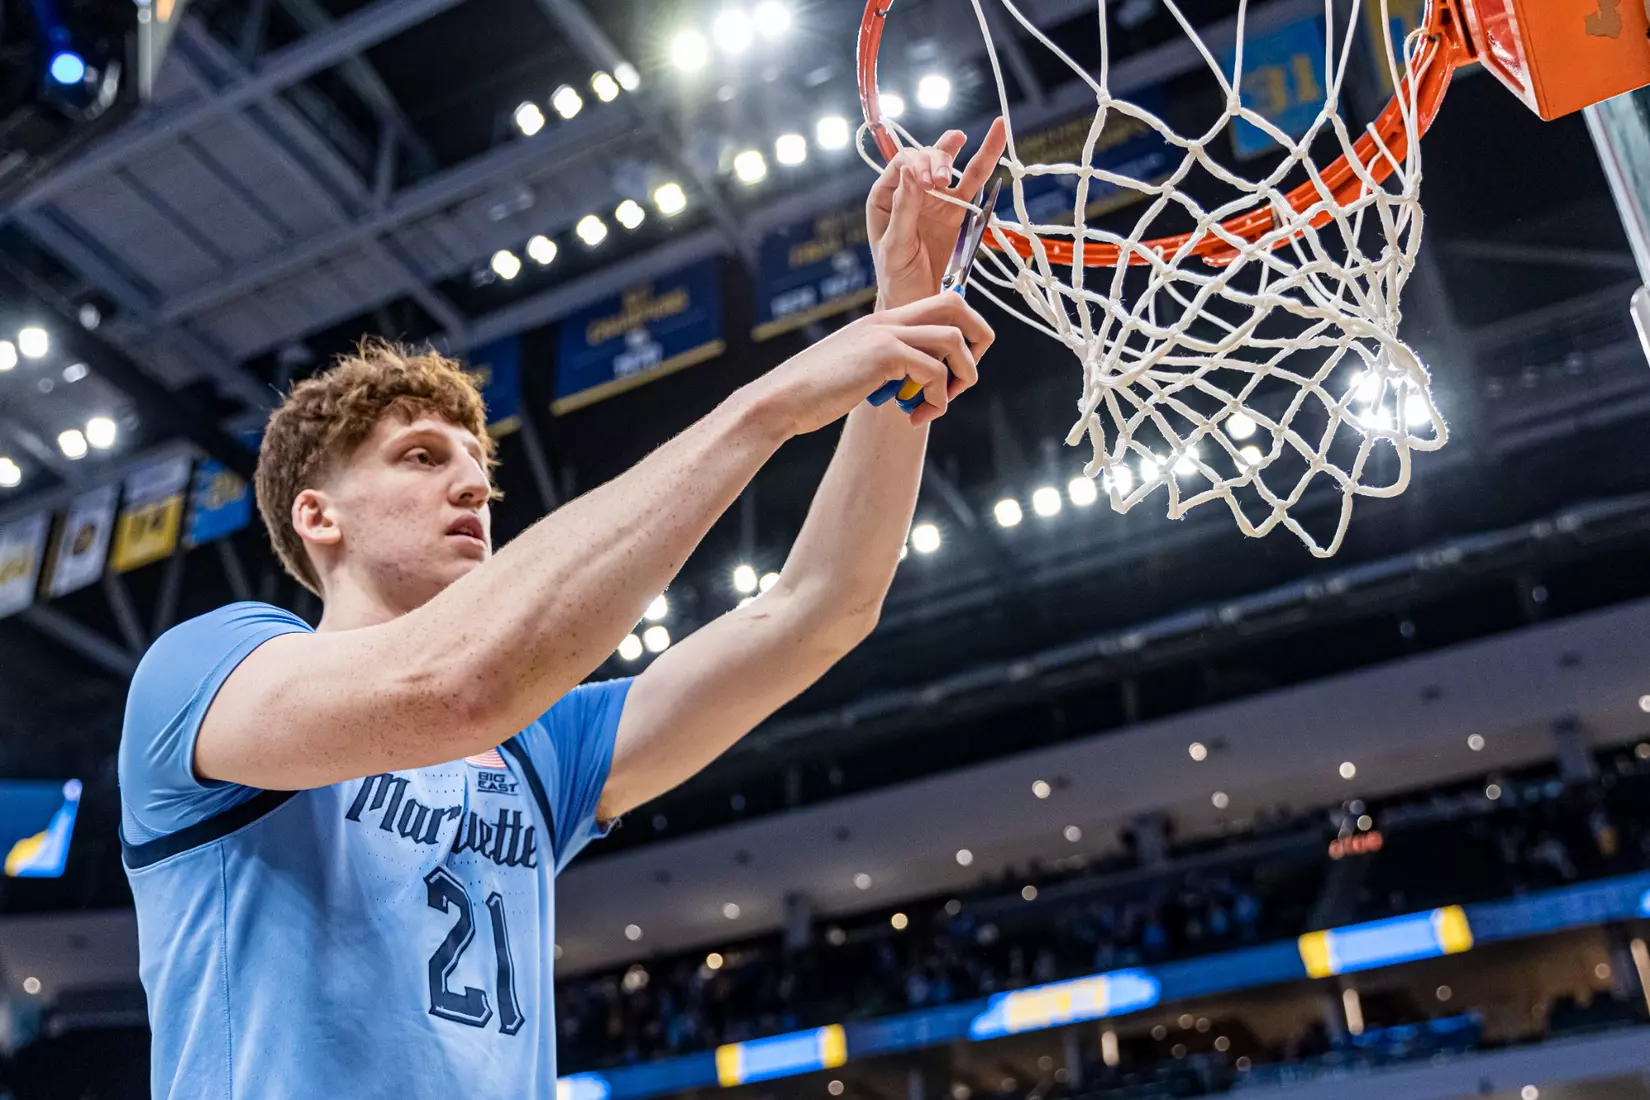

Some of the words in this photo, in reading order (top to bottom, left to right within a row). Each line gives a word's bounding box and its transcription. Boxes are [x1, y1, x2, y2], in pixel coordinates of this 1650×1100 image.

[477, 780, 519, 793] EAST
[478, 771, 506, 783] BIG
[345, 773, 537, 869] Maruette
[423, 866, 525, 1036] 21
